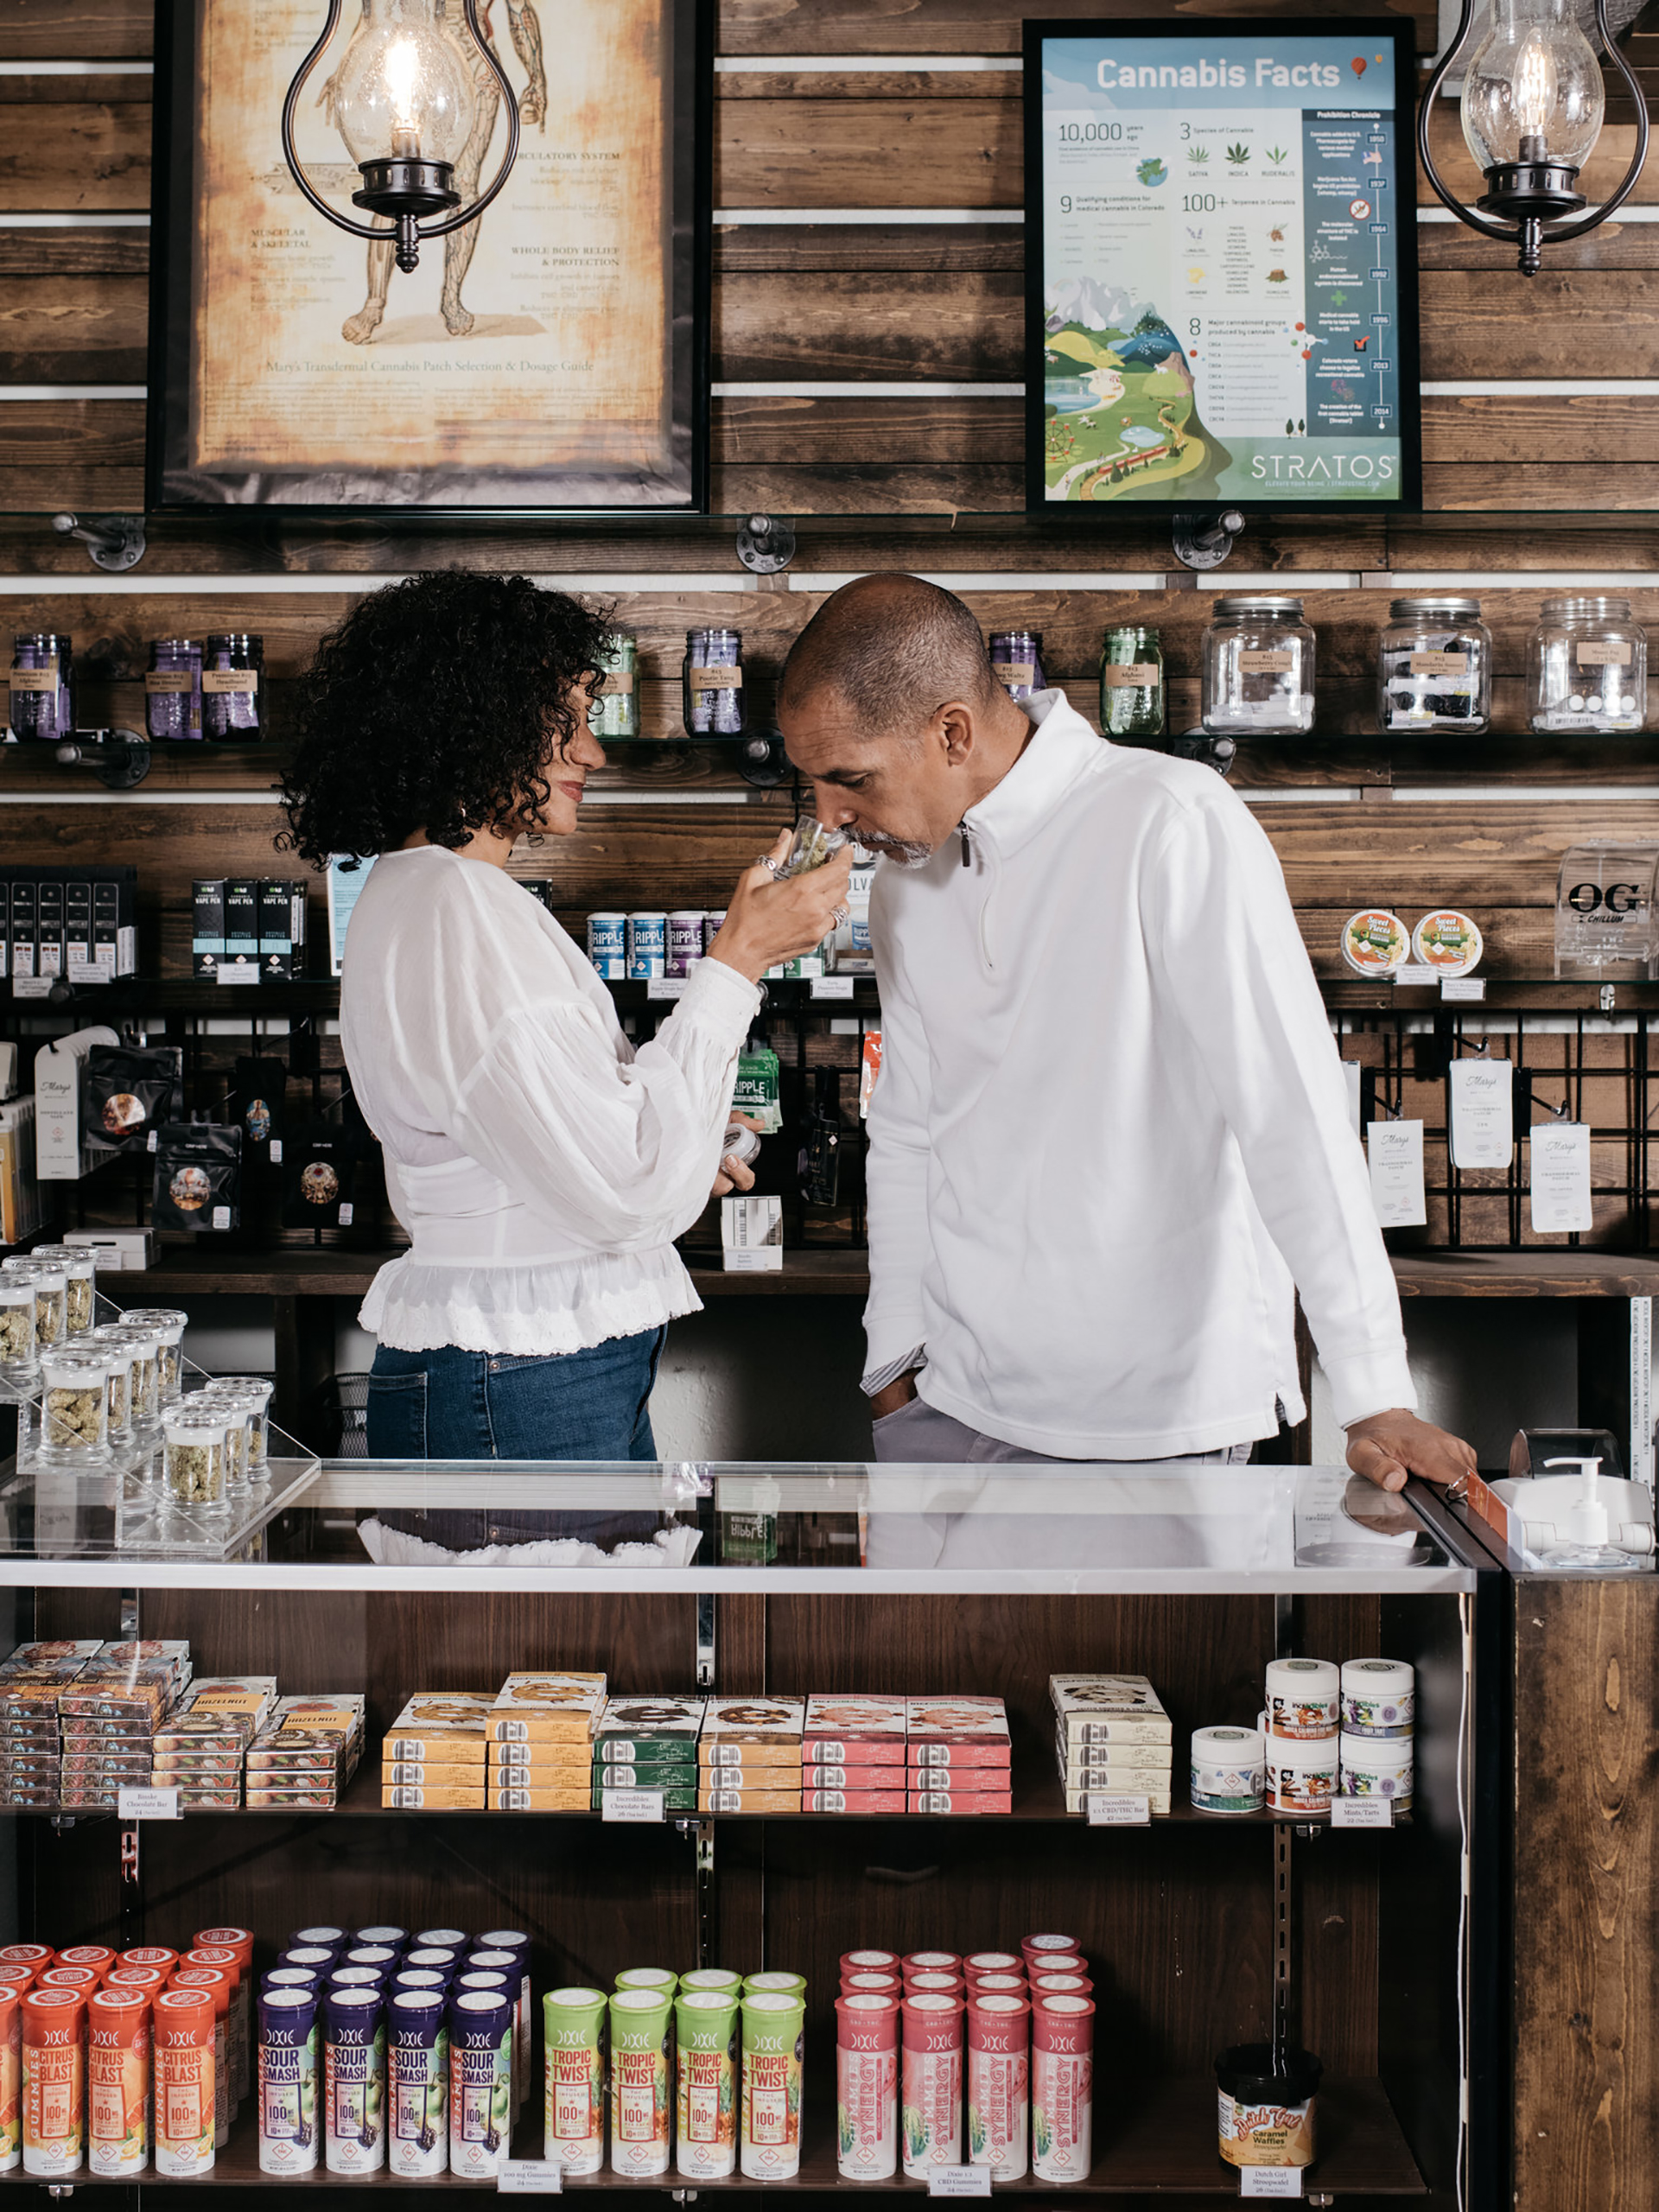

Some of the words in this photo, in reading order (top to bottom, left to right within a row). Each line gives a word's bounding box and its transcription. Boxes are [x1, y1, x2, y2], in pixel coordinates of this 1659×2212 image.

[1097, 59, 1247, 88] Cannabis
[1255, 58, 1340, 88] Facts
[1058, 123, 1122, 143] 10,000
[1179, 122, 1191, 140] 3
[1060, 195, 1072, 214] 9
[1182, 194, 1229, 213] 100+
[1190, 318, 1200, 336] 8
[266, 360, 301, 374] Mary's
[303, 360, 367, 372] Transdermal
[371, 360, 420, 372] Cannabis
[423, 360, 452, 372] Patch
[454, 360, 503, 372] Selection
[505, 361, 517, 372] &
[520, 360, 558, 374] Dosage
[561, 360, 594, 372] Guide
[1251, 454, 1393, 479] STRATOS
[1568, 883, 1640, 913] OG
[1367, 915, 1389, 927] Sweet
[1434, 916, 1457, 926] Sweet
[1587, 914, 1624, 923] CHILLUM
[671, 929, 702, 944] RIPPLE
[1369, 924, 1391, 934] Pieces
[1438, 924, 1460, 932] Pieces
[593, 930, 624, 944] RIPPLE
[1346, 1698, 1380, 1708] incredibles
[1345, 1770, 1378, 1780] incredibles
[44, 2028, 70, 2046] DIXIE
[168, 2030, 196, 2047] DIXIE
[266, 2028, 295, 2045] DIXIE
[466, 2032, 491, 2048] DIXIE
[557, 2029, 587, 2045] DIXIE
[754, 2034, 783, 2051] DIXIE
[851, 2032, 879, 2050] DIXIE
[982, 2034, 1009, 2051] DIXIE
[1049, 2034, 1076, 2051] DIXIE
[39, 2048, 74, 2064] CITRUS
[163, 2049, 202, 2066] CITRUS
[263, 2048, 299, 2067] SOUR
[461, 2051, 494, 2069] SOUR
[553, 2050, 592, 2065] TROPIC
[750, 2054, 788, 2070] TROPIC
[40, 2063, 74, 2082] BLAST
[164, 2063, 203, 2082] BLAST
[263, 2065, 300, 2082] SMASH
[461, 2069, 494, 2083] SMASH
[553, 2064, 592, 2082] TWIST
[750, 2069, 788, 2088] TWIST
[30, 2049, 40, 2139] GUMMIES
[860, 2054, 875, 2145] SYNERGY
[989, 2056, 1006, 2146] SYNERGY
[1057, 2056, 1071, 2148] SYNERGY
[46, 2106, 61, 2120] 100
[269, 2106, 287, 2120] 100
[559, 2106, 578, 2120] 100
[1233, 2107, 1270, 2142] Dutch
[1269, 2107, 1303, 2129] Girl
